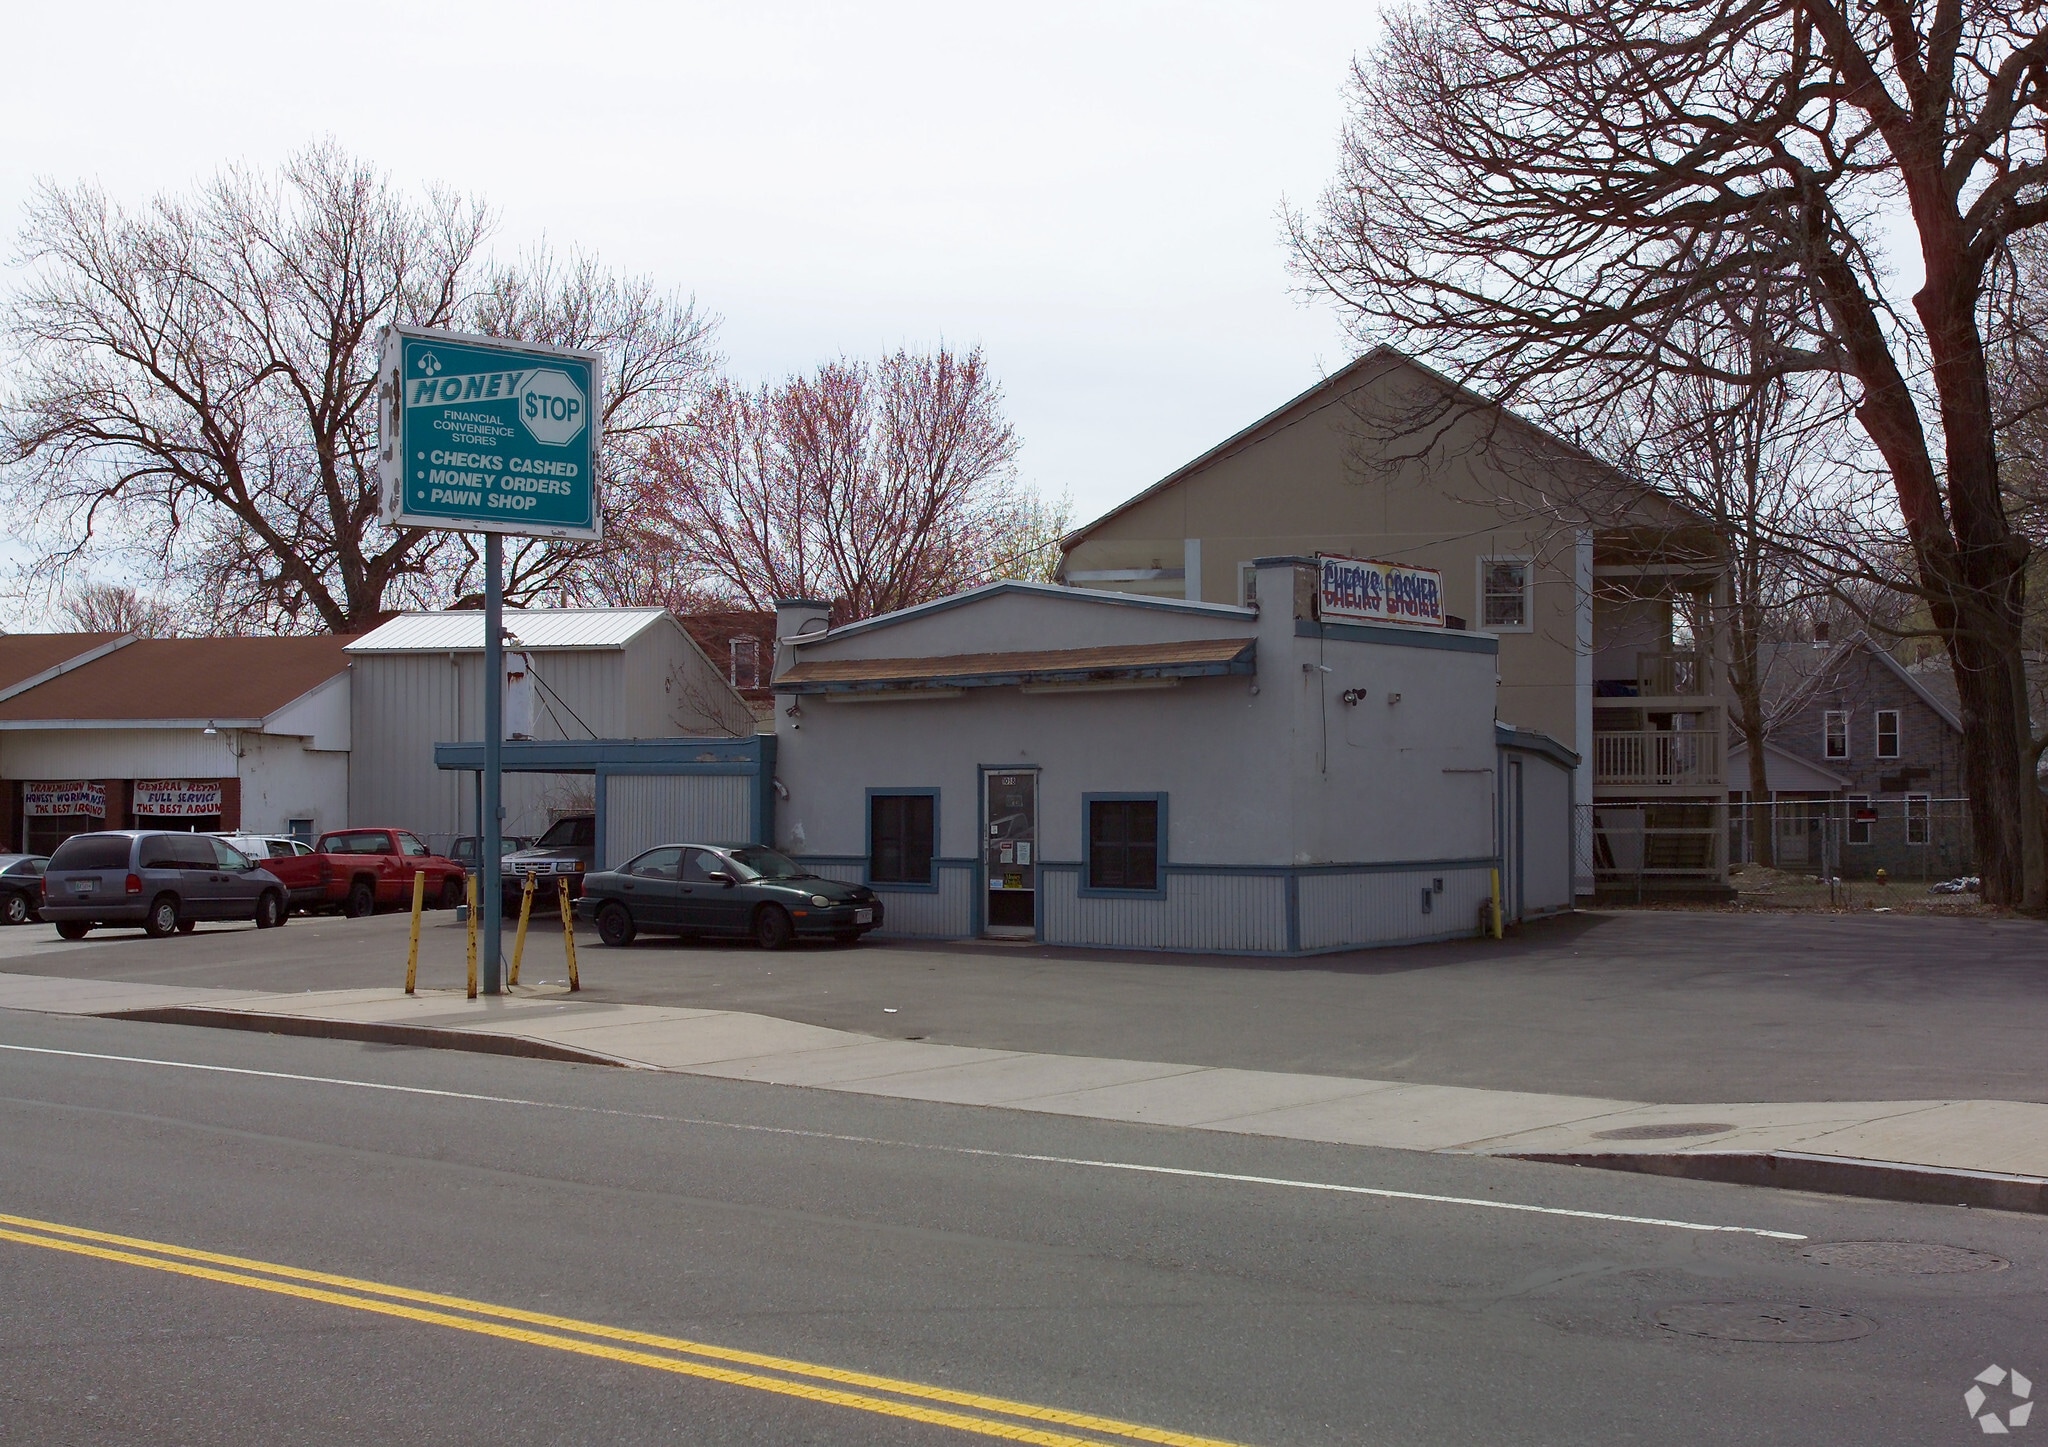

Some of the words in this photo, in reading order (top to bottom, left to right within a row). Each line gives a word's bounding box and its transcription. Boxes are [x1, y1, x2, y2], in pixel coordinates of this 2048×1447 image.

[414, 372, 525, 404] MONEY
[525, 390, 580, 422] $TOP
[444, 410, 504, 425] FINANCIAL
[433, 420, 515, 437] CONVENIENCE
[452, 433, 497, 446] STORES
[430, 450, 503, 470] CHECKS
[509, 457, 578, 477] CASHED
[429, 469, 496, 489] MONEY
[501, 477, 571, 495] ORDERS
[430, 488, 481, 507] PAWN
[487, 493, 537, 511] SHOP
[137, 782, 182, 791] GENERAL
[25, 793, 53, 803] HONEST
[147, 793, 172, 803] FULL
[177, 792, 216, 803] SERVICE
[35, 804, 49, 814] THE
[52, 804, 71, 814] BEST
[136, 803, 154, 813] THE
[159, 804, 182, 814] BEST
